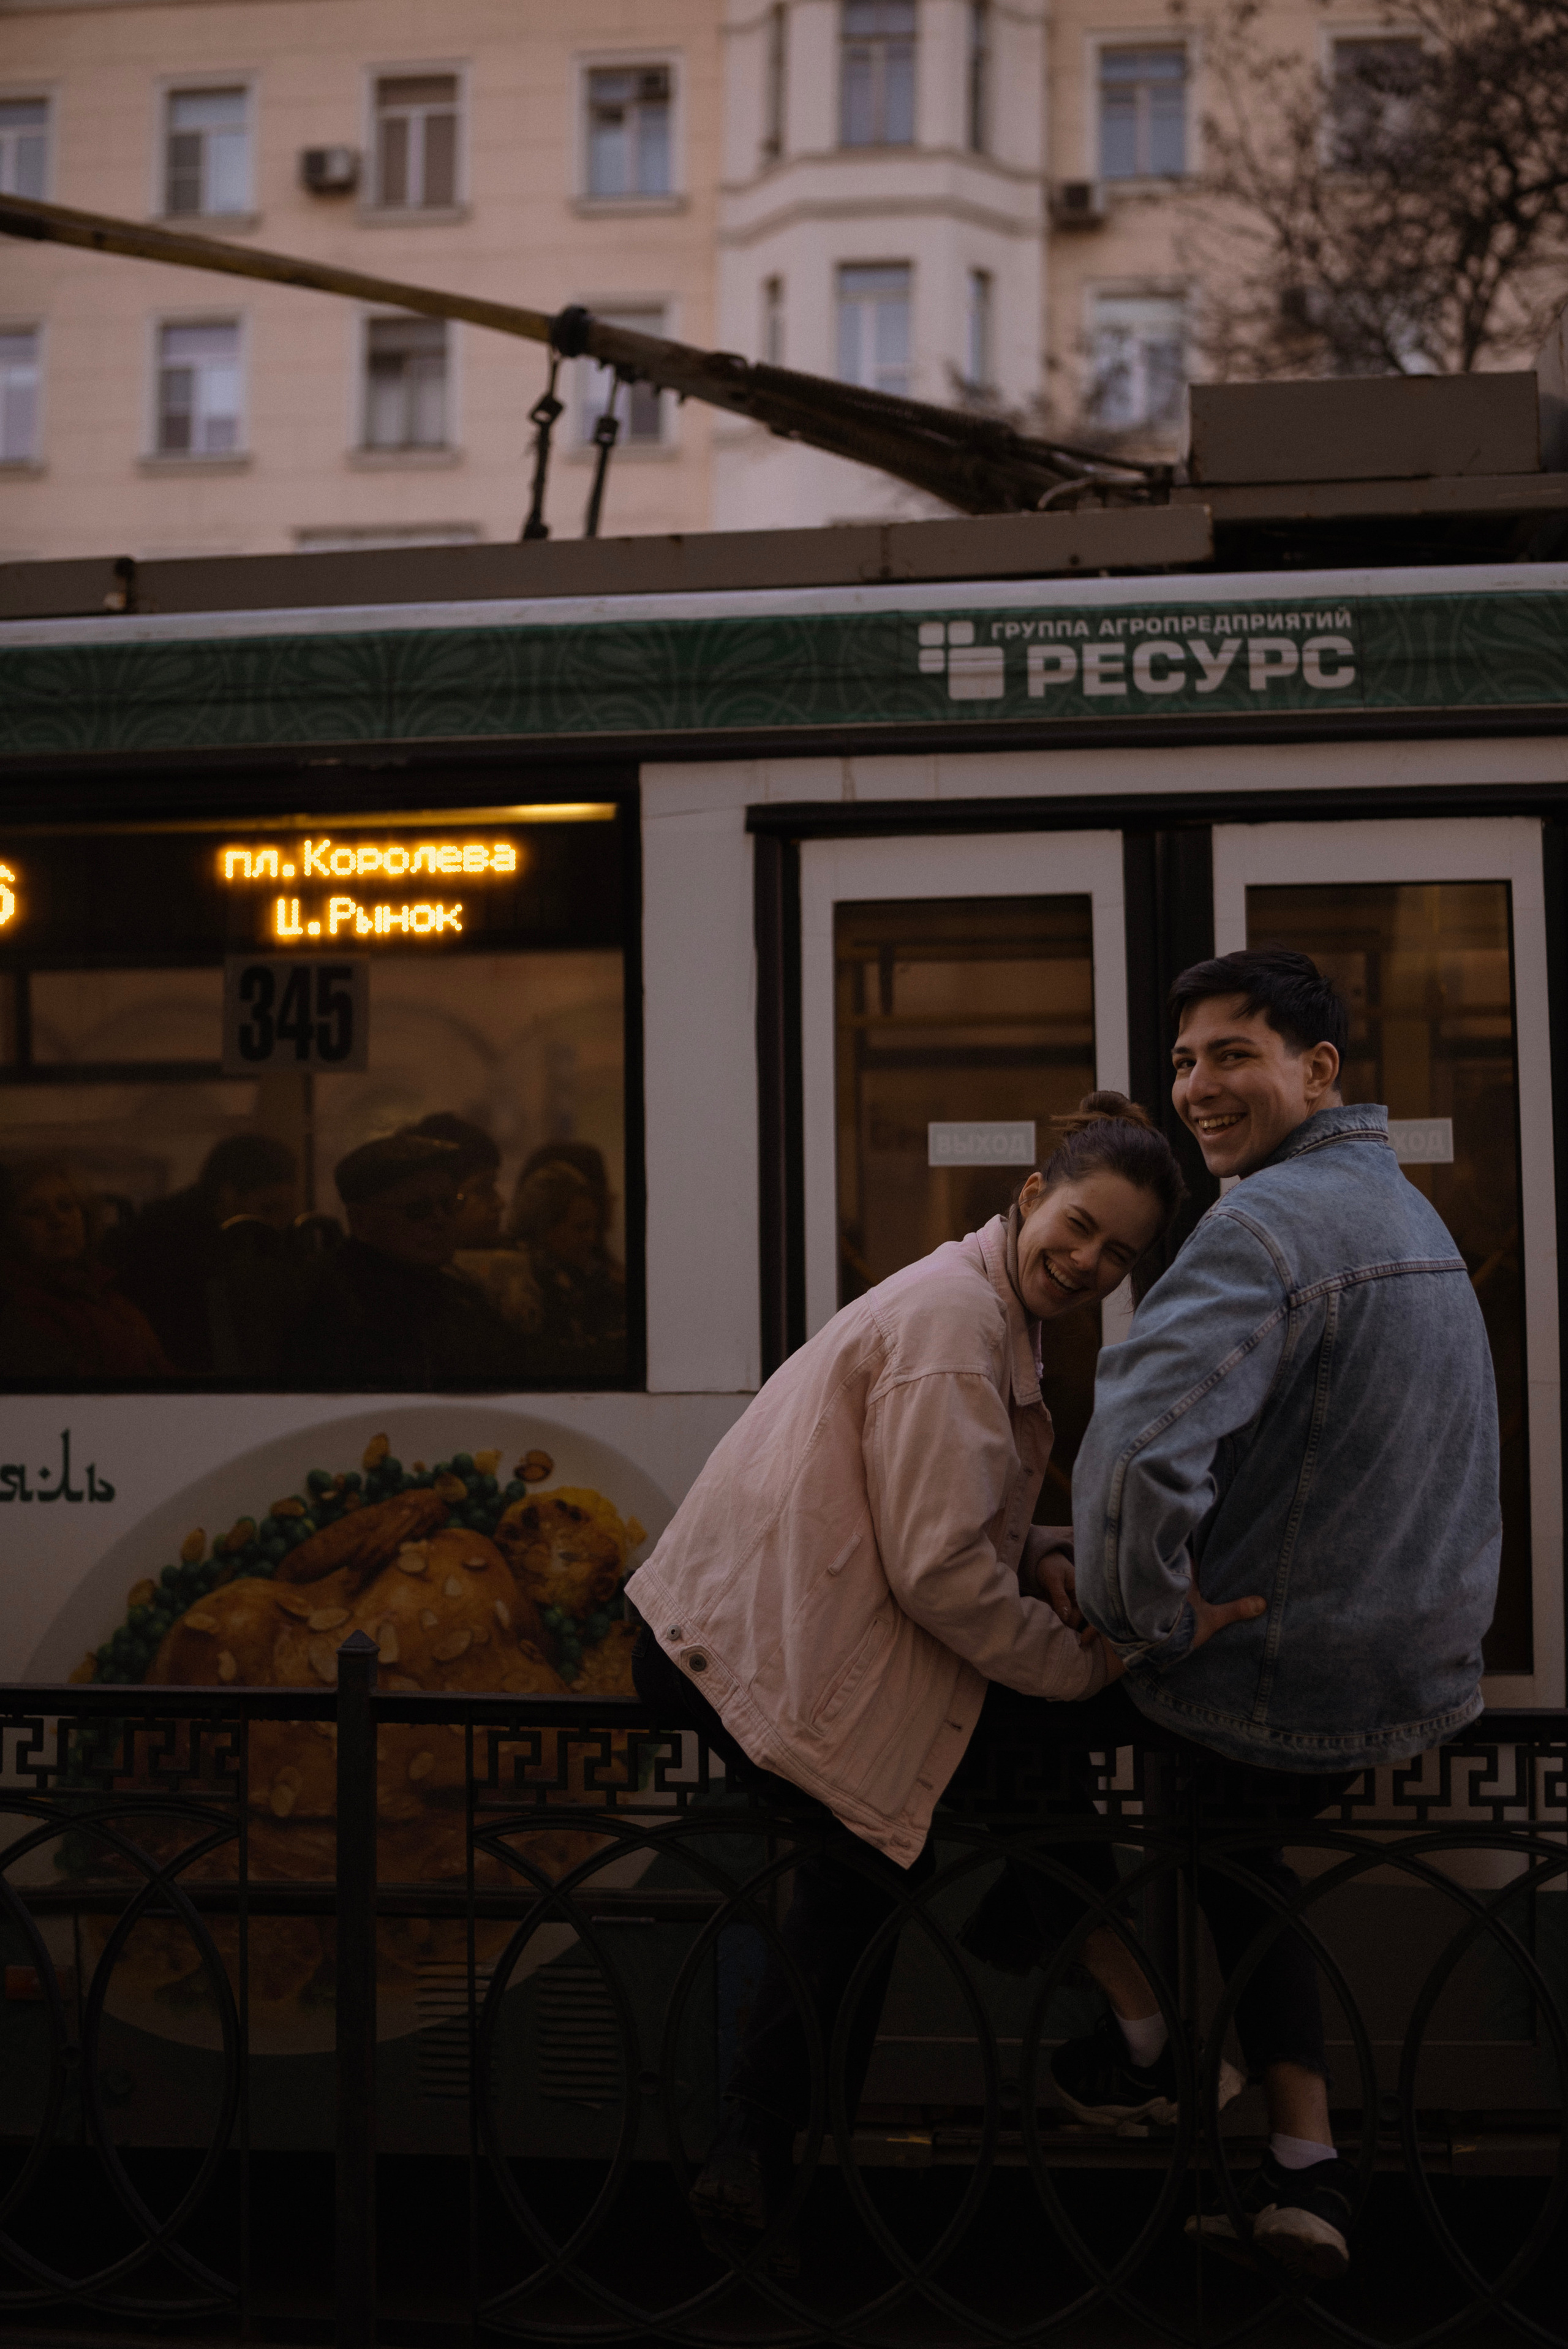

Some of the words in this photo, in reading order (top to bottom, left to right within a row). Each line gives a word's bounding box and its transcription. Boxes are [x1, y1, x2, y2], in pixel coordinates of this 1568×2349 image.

[991, 620, 1090, 640] ГРУППА
[1098, 607, 1352, 636] АГРОПРЕДПРИЯТИЙ
[1027, 636, 1355, 697] РЕСУРС
[238, 966, 353, 1062] 345
[935, 1132, 1027, 1157] ВЫХОД
[1389, 1129, 1446, 1156] ХОД
